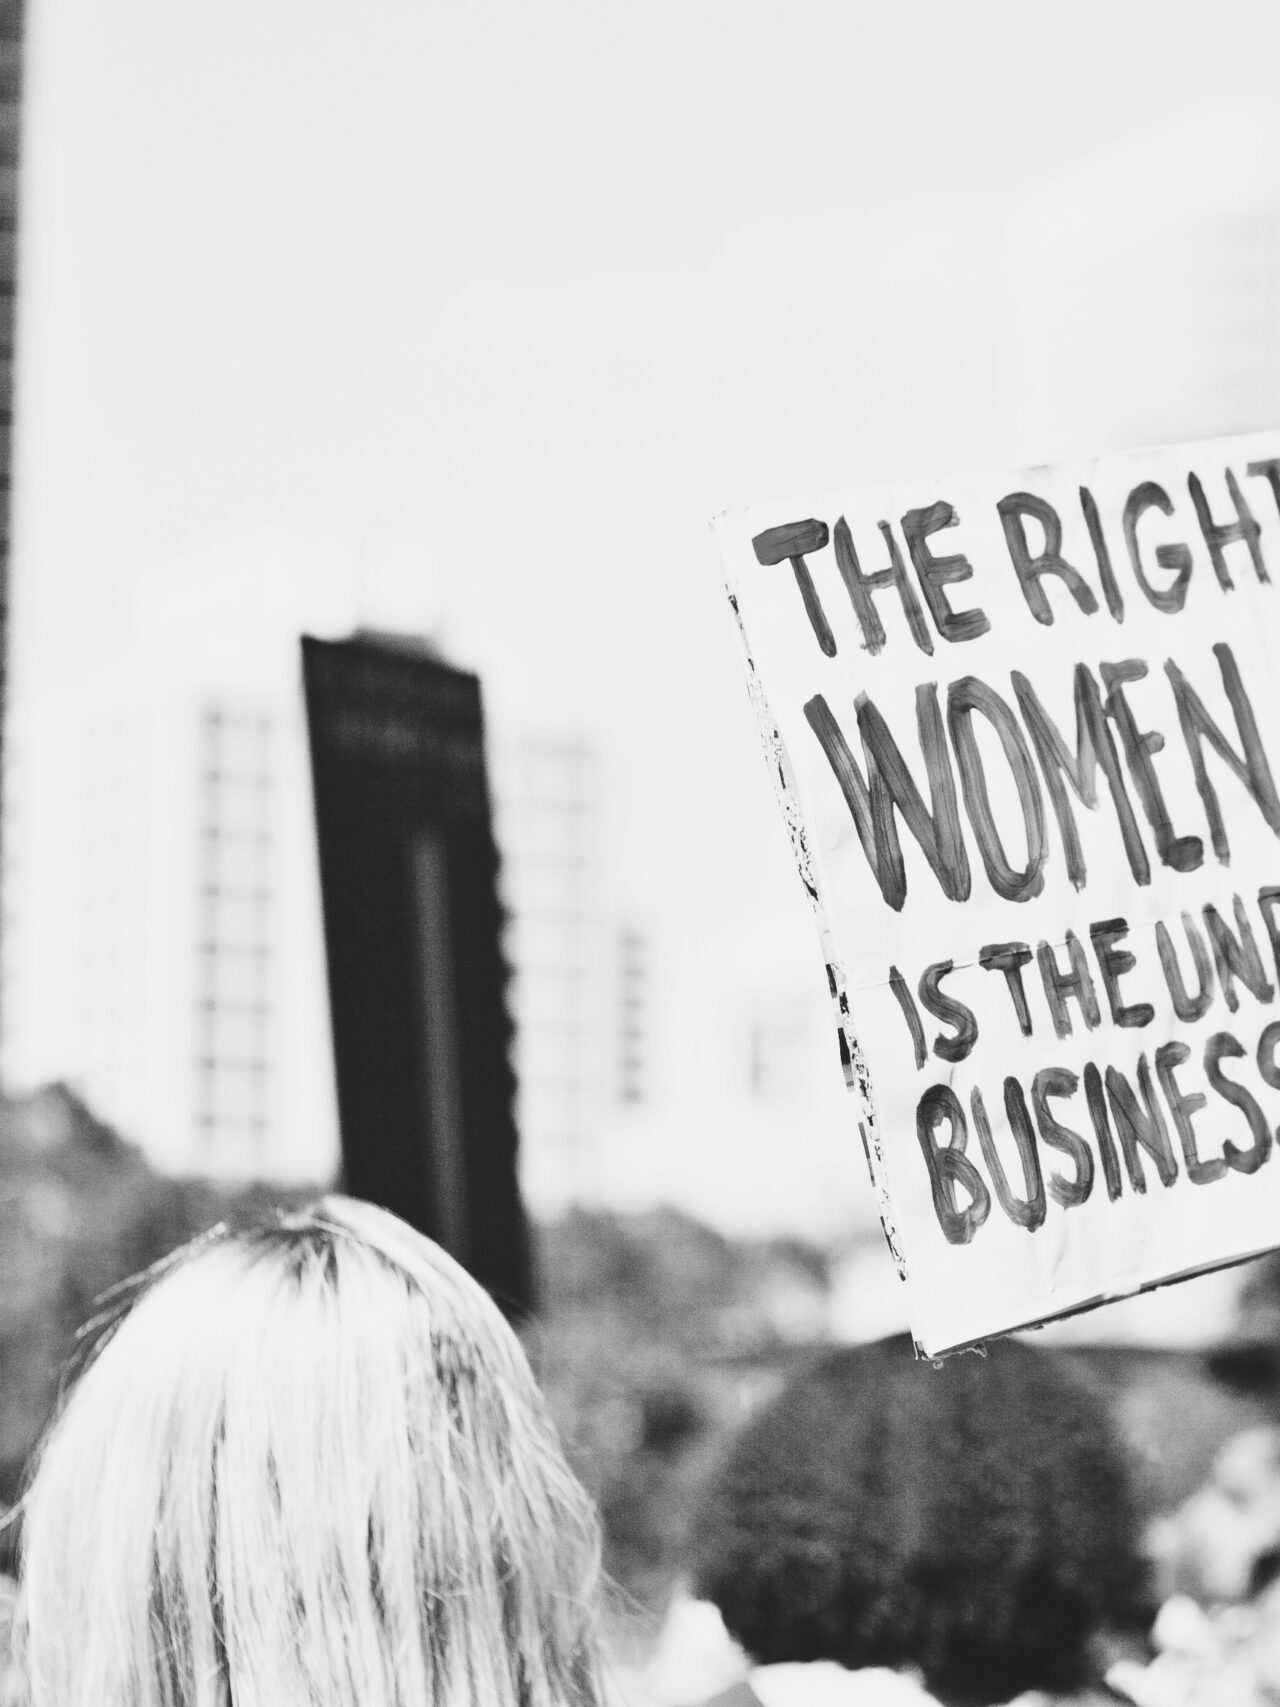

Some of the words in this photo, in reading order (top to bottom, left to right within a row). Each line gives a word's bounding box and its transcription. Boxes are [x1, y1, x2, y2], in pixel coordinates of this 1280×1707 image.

[752, 501, 991, 658] THE
[889, 959, 979, 1070] IS
[979, 918, 1155, 1040] THE
